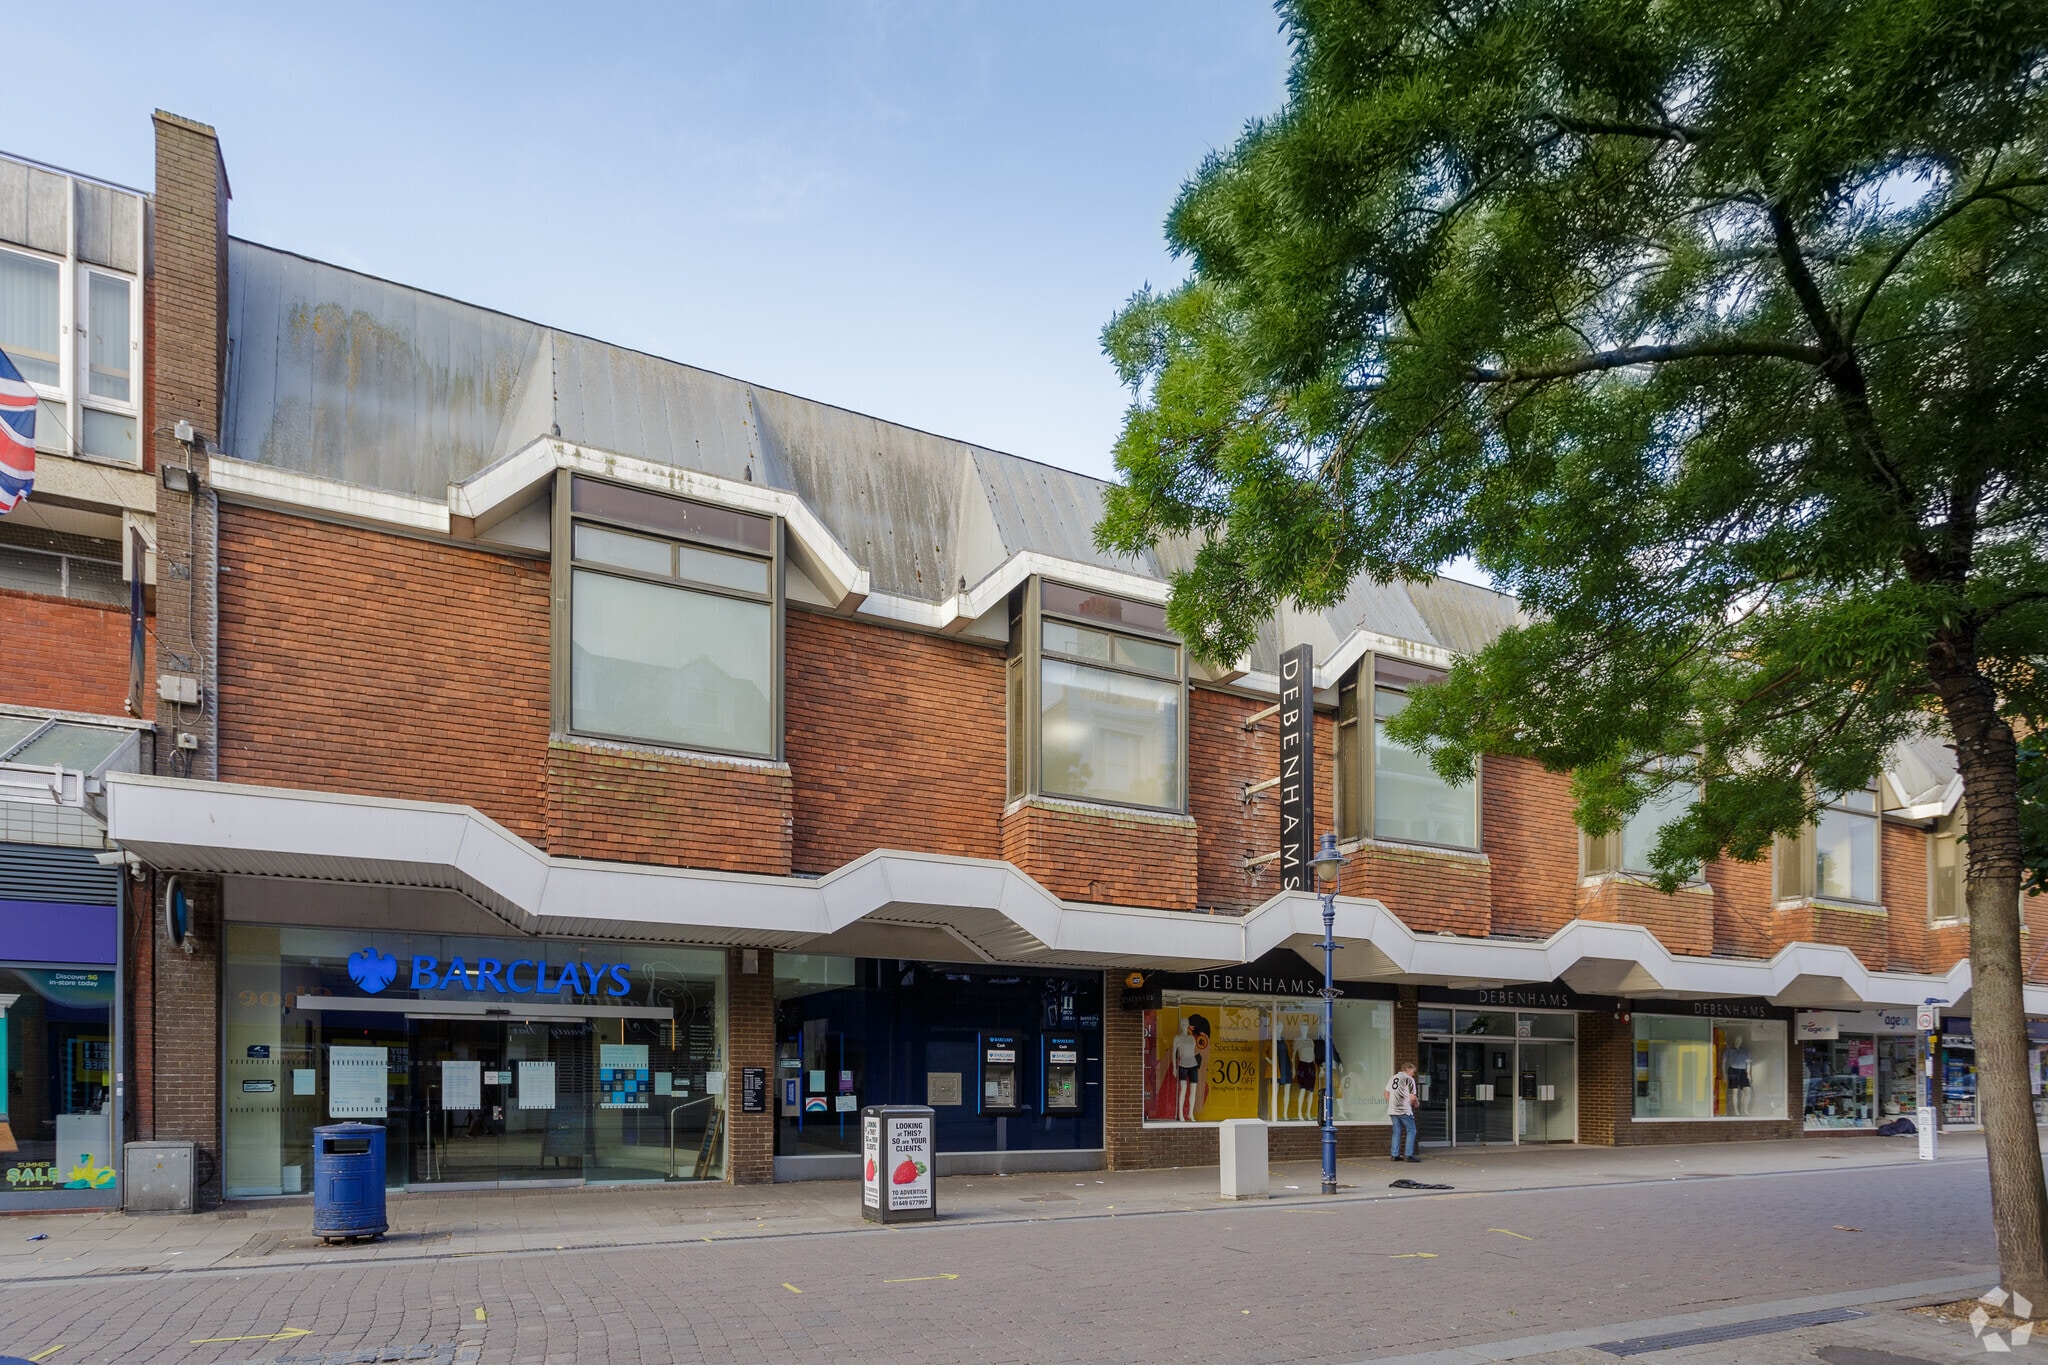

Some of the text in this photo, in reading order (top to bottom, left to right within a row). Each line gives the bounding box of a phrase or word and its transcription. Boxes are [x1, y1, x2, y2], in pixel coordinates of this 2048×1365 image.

[1283, 658, 1300, 890] DEBENHAMS
[410, 955, 631, 996] BARCLAYS
[1199, 974, 1315, 994] DEBENHAMS
[1479, 990, 1568, 1007] DEBENHAMS
[1694, 1002, 1765, 1017] DEBENHAMS
[1214, 1042, 1254, 1052] Spectacular
[1212, 1060, 1255, 1084] 30%
[1392, 1078, 1399, 1090] 8
[895, 1122, 923, 1130] LOOKING
[6, 1167, 60, 1185] SALE
